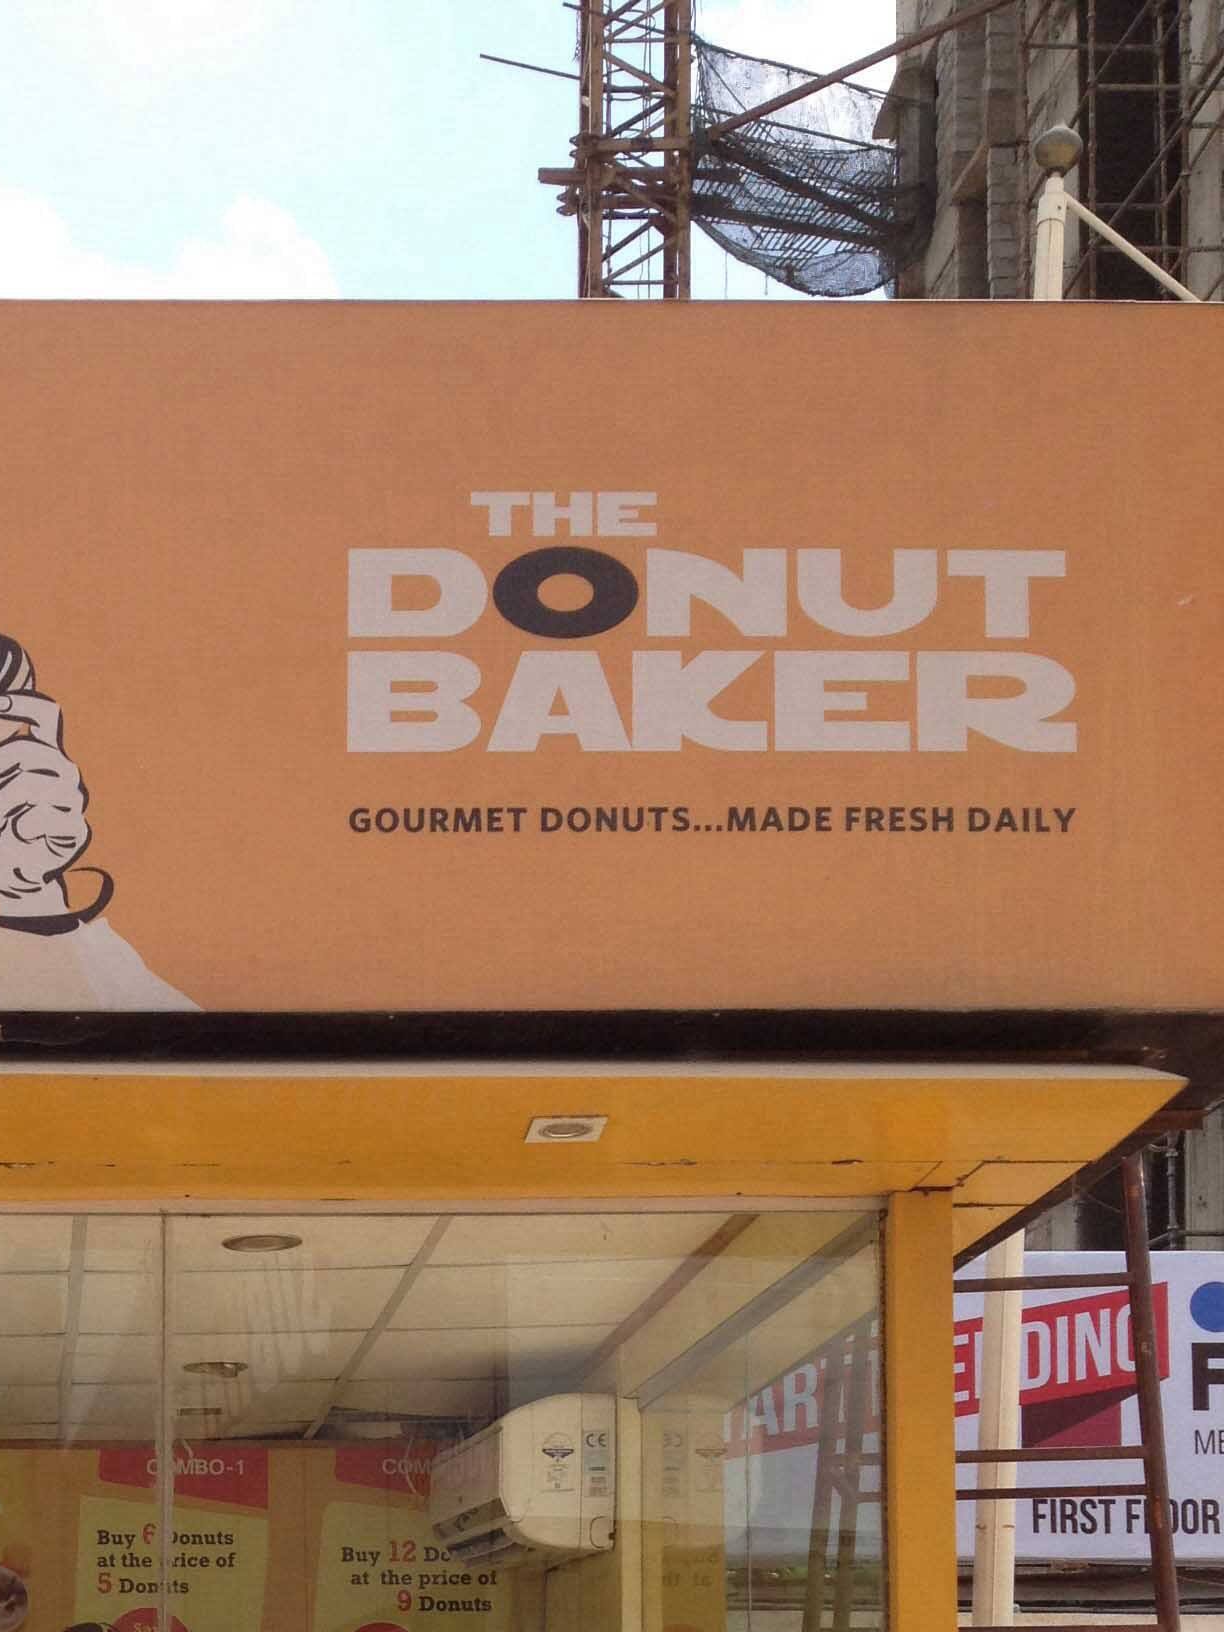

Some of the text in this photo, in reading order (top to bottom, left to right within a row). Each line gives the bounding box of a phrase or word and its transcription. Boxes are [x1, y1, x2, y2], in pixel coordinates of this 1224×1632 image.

[471, 491, 657, 537] THE
[348, 547, 1066, 639] DONUT
[347, 650, 1077, 753] BAKER
[349, 806, 528, 834] GOURMET
[846, 806, 955, 834] FRESH
[968, 806, 1076, 834] DAILY
[146, 1458, 246, 1476] CMBO-1
[1032, 1498, 1116, 1534] FIRST
[97, 1529, 137, 1549] Buy
[97, 1555, 116, 1567] at
[121, 1552, 153, 1567] the
[216, 1552, 237, 1567] of
[341, 1546, 381, 1567] Buy
[389, 1540, 417, 1562] 12
[97, 1572, 112, 1594] 5
[351, 1570, 498, 1589] at the price of
[397, 1590, 492, 1612] 9 Donuts
